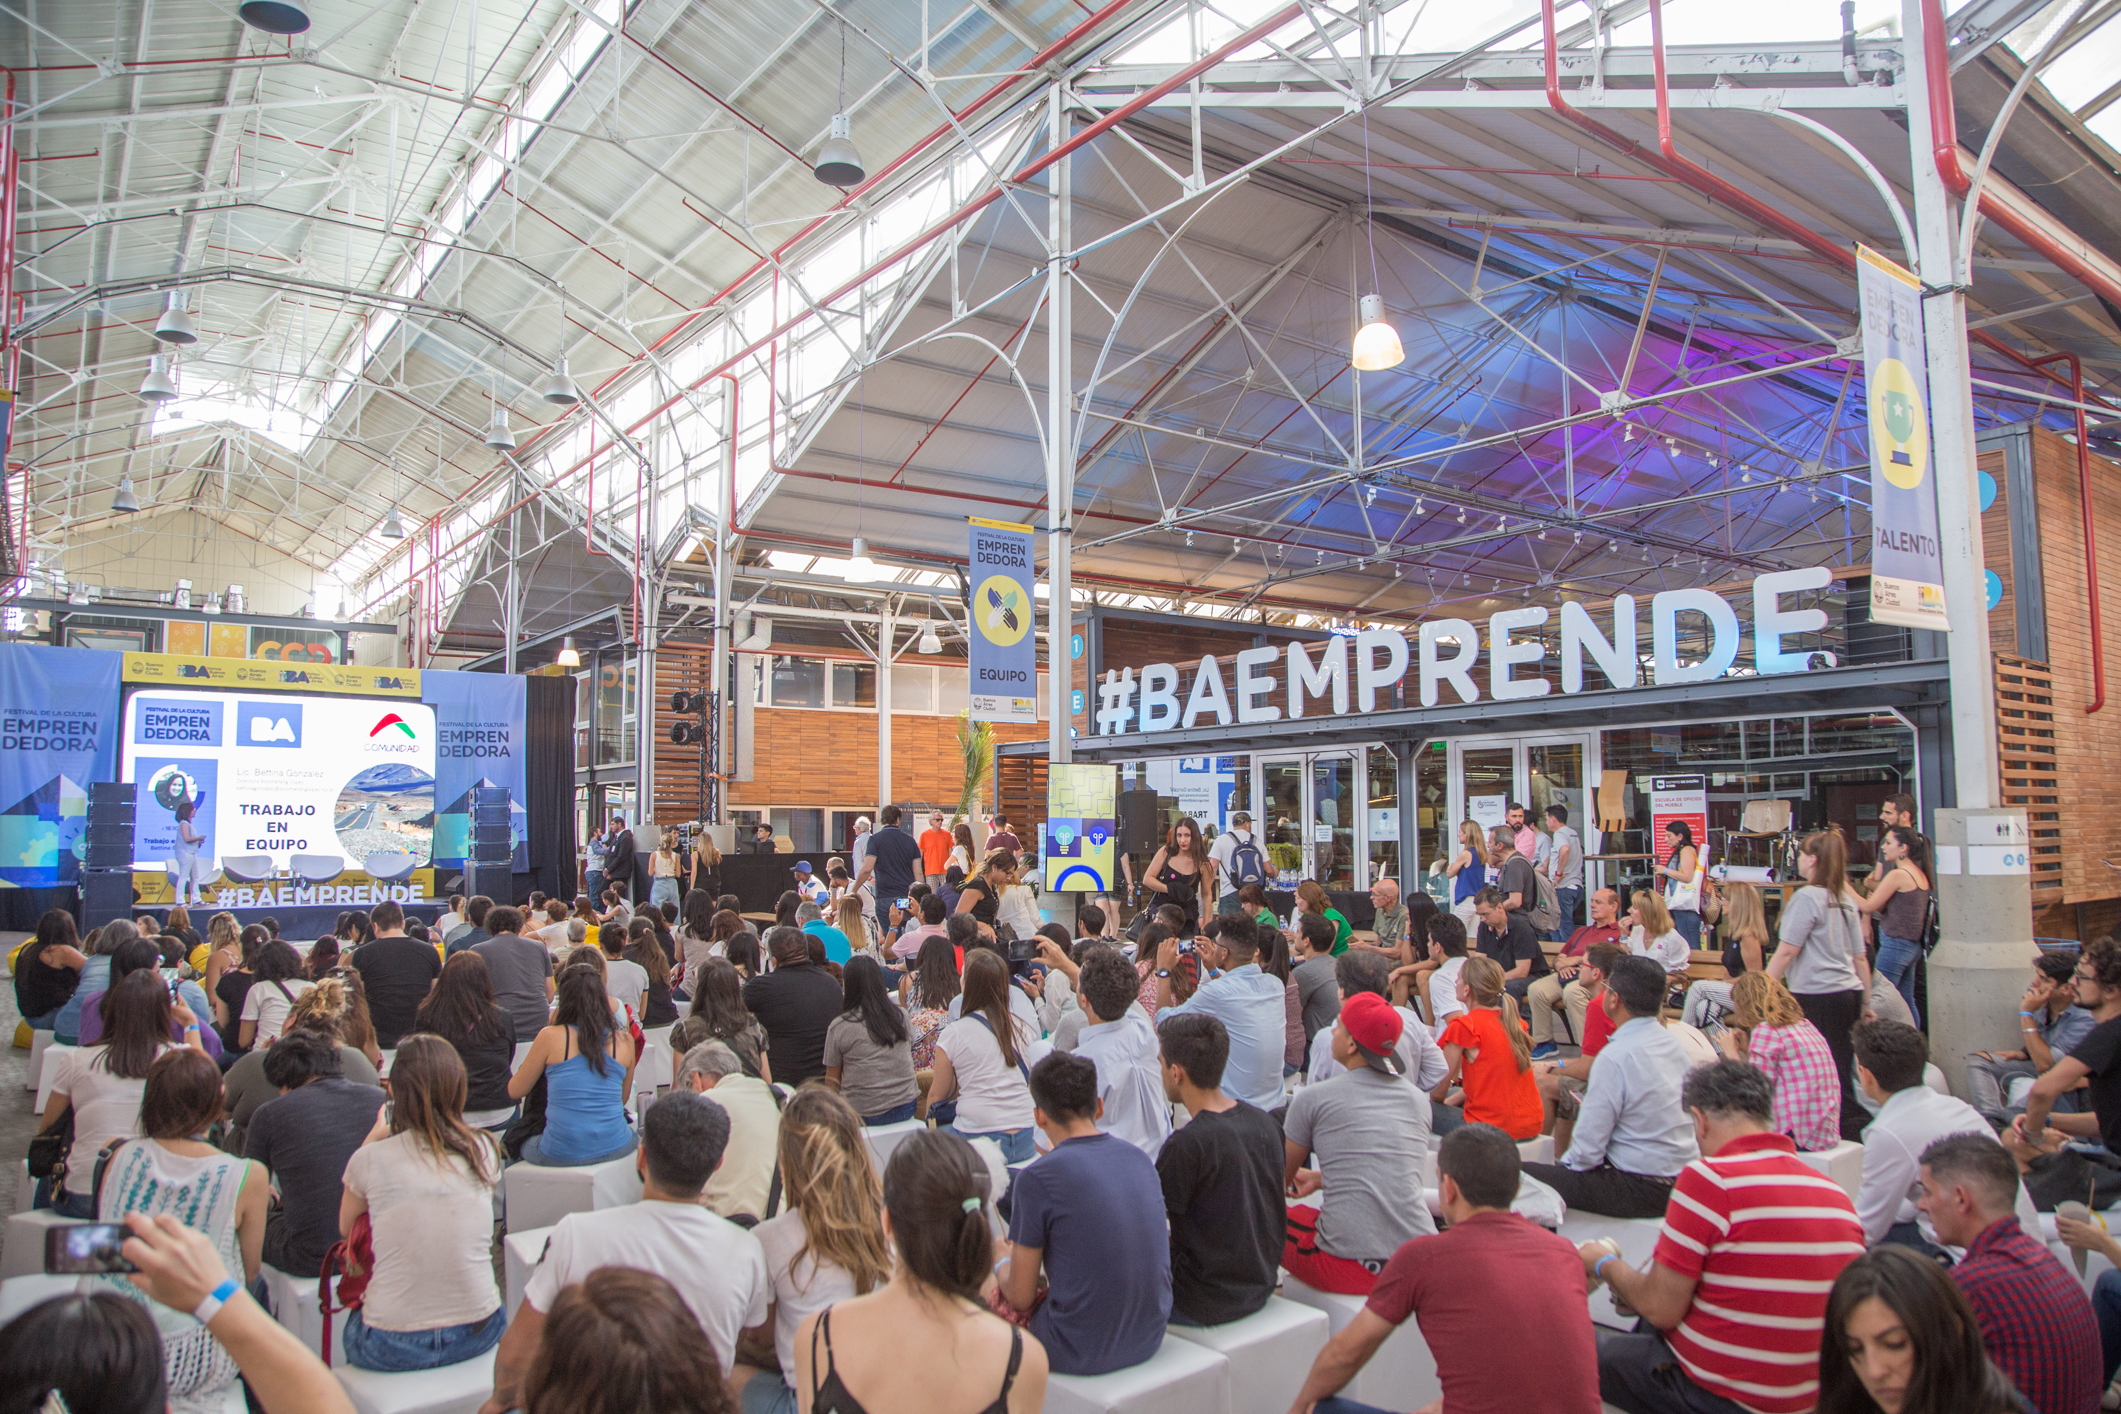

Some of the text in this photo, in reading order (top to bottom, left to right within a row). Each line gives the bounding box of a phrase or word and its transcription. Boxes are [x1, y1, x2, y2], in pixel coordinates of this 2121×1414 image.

[977, 531, 995, 539] FESTIVAL
[1875, 526, 1935, 558] TALENTO
[977, 539, 1026, 556] EMPREN
[977, 551, 1027, 569] DEDORA
[1884, 581, 1900, 591] Buenos
[1885, 590, 1896, 598] Aires
[1073, 639, 1078, 653] 1
[1096, 566, 1838, 736] #BAEMPRENDE
[979, 668, 1027, 682] EQUIPO
[1073, 695, 1081, 709] E
[4, 708, 39, 716] FESTIVAL
[3, 718, 97, 736] EMPREN
[145, 714, 210, 728] EMPREN
[144, 727, 211, 741] DEDORA
[250, 716, 296, 743] BA
[439, 730, 509, 743] EMPREN
[2, 735, 98, 752] DEDORA
[364, 743, 420, 753] COMUNIDAD
[439, 745, 510, 758] DEDORA
[254, 768, 284, 777] Bettina
[286, 769, 324, 778] Gonzalez
[239, 804, 316, 816] TRABAJO
[266, 821, 288, 833] EN
[245, 838, 308, 851] EQUIPO
[218, 885, 425, 908] #BAEMPRENDE
